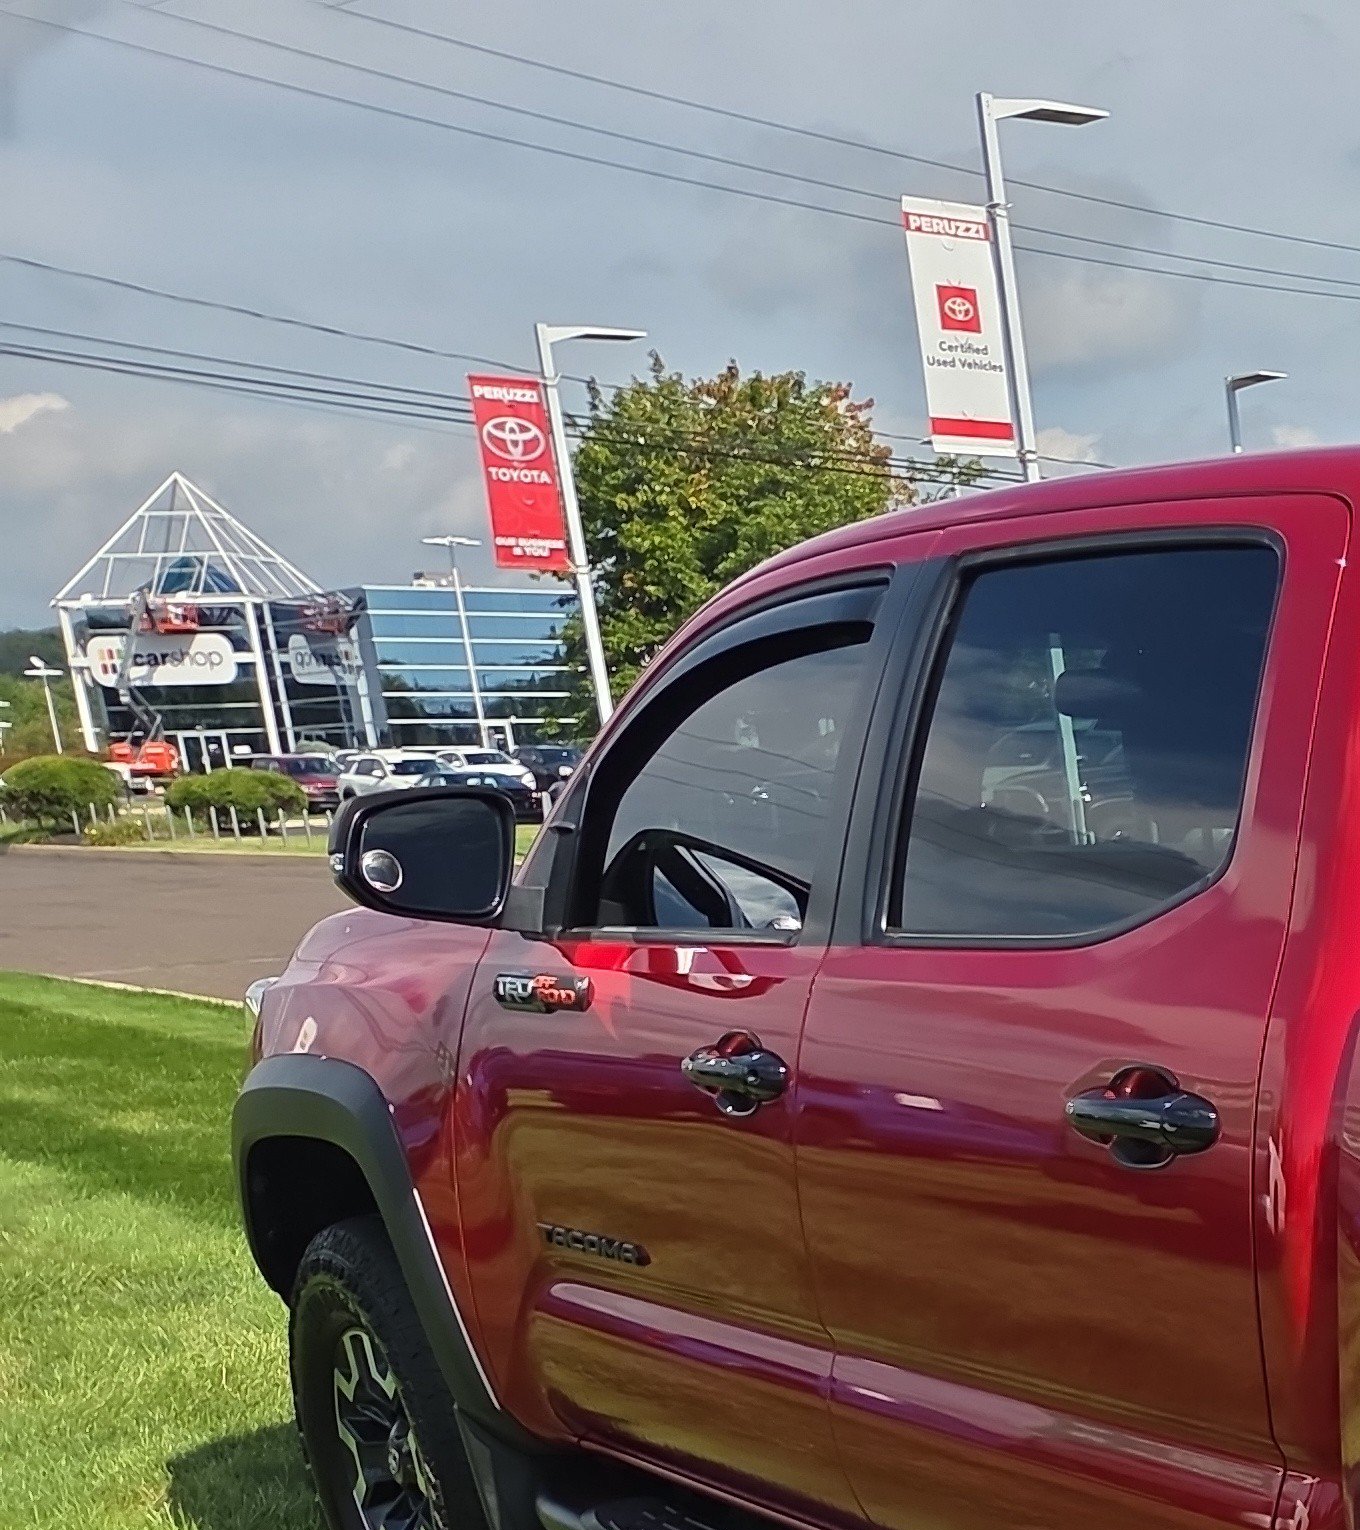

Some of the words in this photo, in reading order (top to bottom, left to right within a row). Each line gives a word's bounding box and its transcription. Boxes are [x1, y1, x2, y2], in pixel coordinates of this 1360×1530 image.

[909, 216, 985, 238] PERUZZI
[938, 341, 989, 356] Certified
[927, 356, 956, 369] Used
[959, 357, 1003, 372] Vehicles
[472, 385, 540, 403] PERUZZI
[488, 467, 552, 484] TOYOTA
[132, 648, 224, 671] carshop
[536, 1222, 640, 1265] TACOMA
